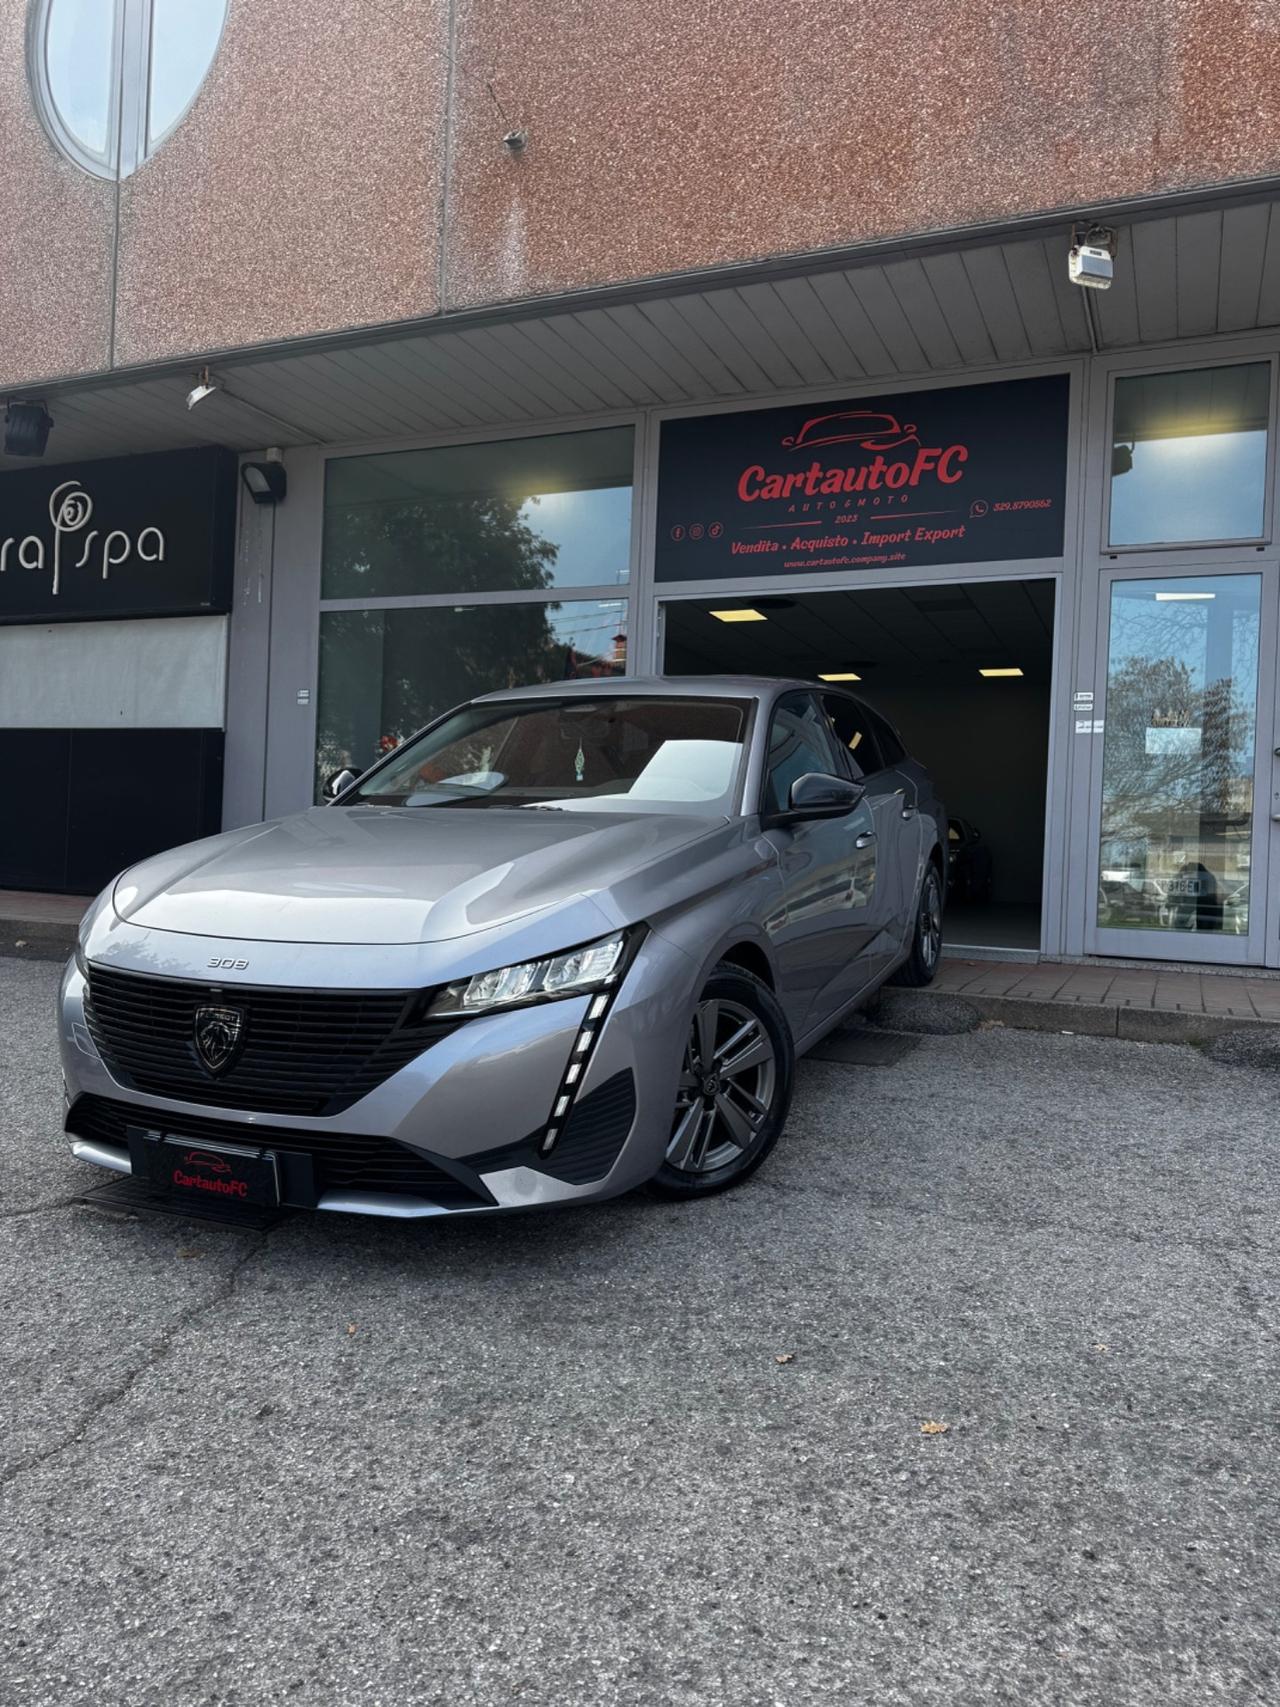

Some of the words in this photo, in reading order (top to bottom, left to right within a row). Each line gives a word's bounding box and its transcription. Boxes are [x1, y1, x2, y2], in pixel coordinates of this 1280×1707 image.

[737, 445, 968, 502] CartautoFC
[75, 526, 165, 580] spa
[731, 541, 779, 555] Vendita
[790, 534, 849, 552] Acquisto
[861, 528, 912, 546] Import
[914, 524, 966, 544] Export
[784, 552, 907, 568] www.cartautofc.company.site
[207, 957, 250, 970] 308
[172, 1171, 248, 1198] CartautoFC
